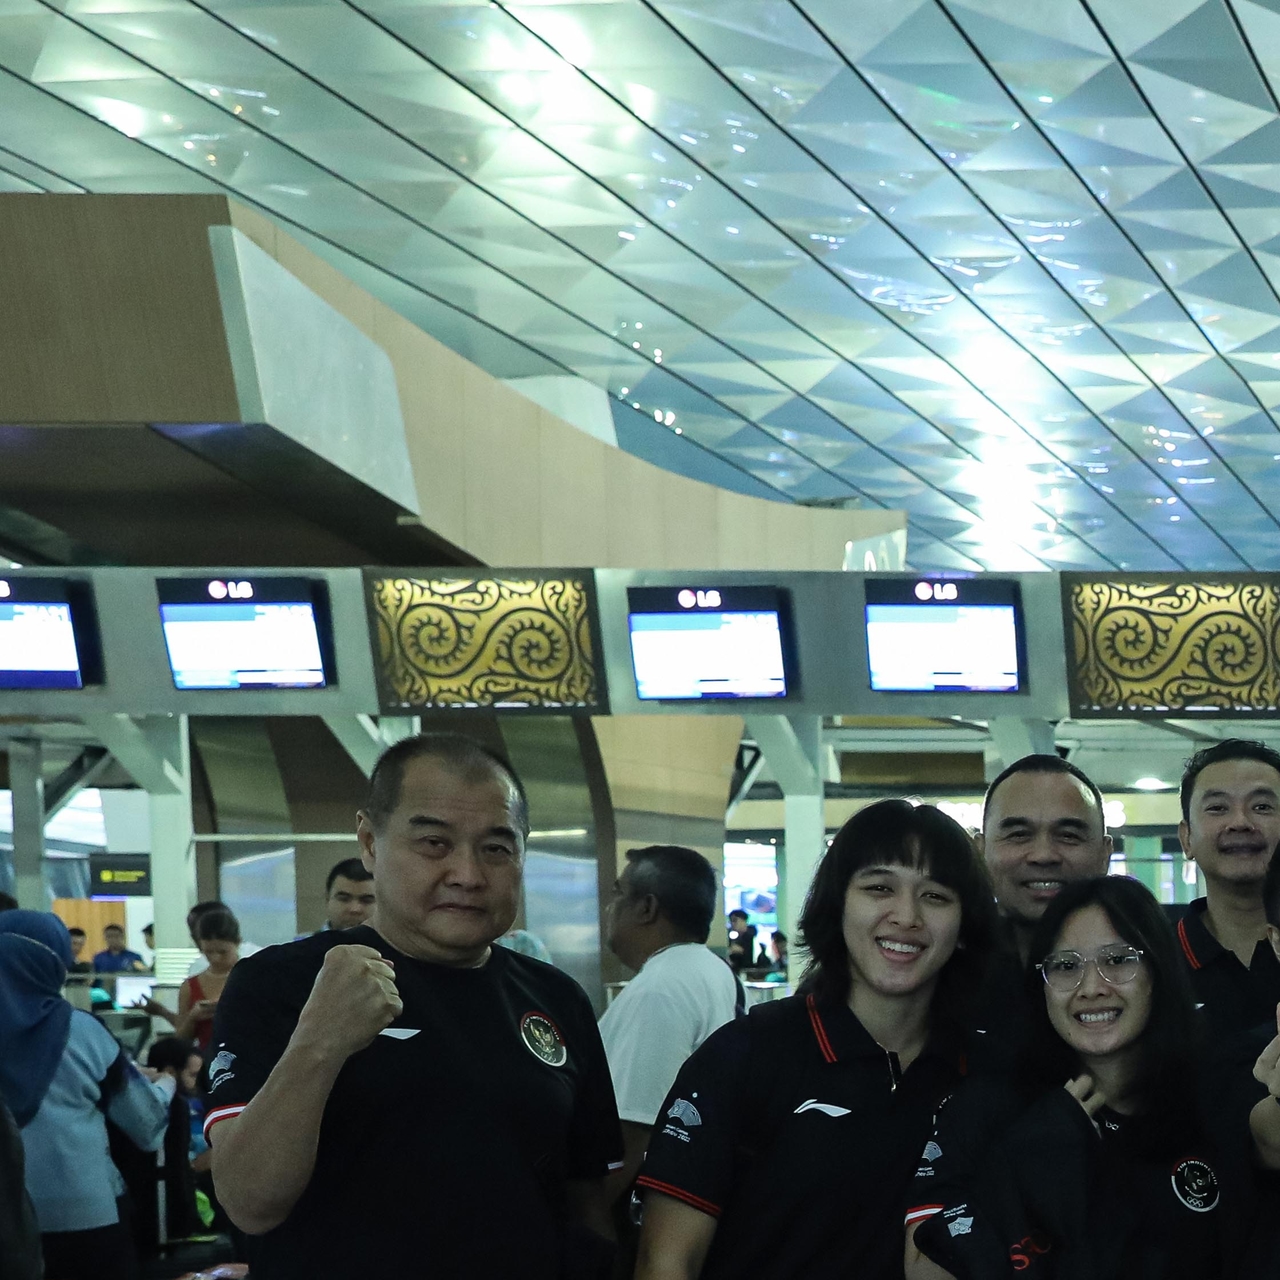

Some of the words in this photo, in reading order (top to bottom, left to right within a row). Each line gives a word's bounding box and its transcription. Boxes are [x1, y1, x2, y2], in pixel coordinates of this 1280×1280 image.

[227, 581, 254, 598] LG
[934, 583, 958, 600] LG
[697, 590, 722, 607] LG
